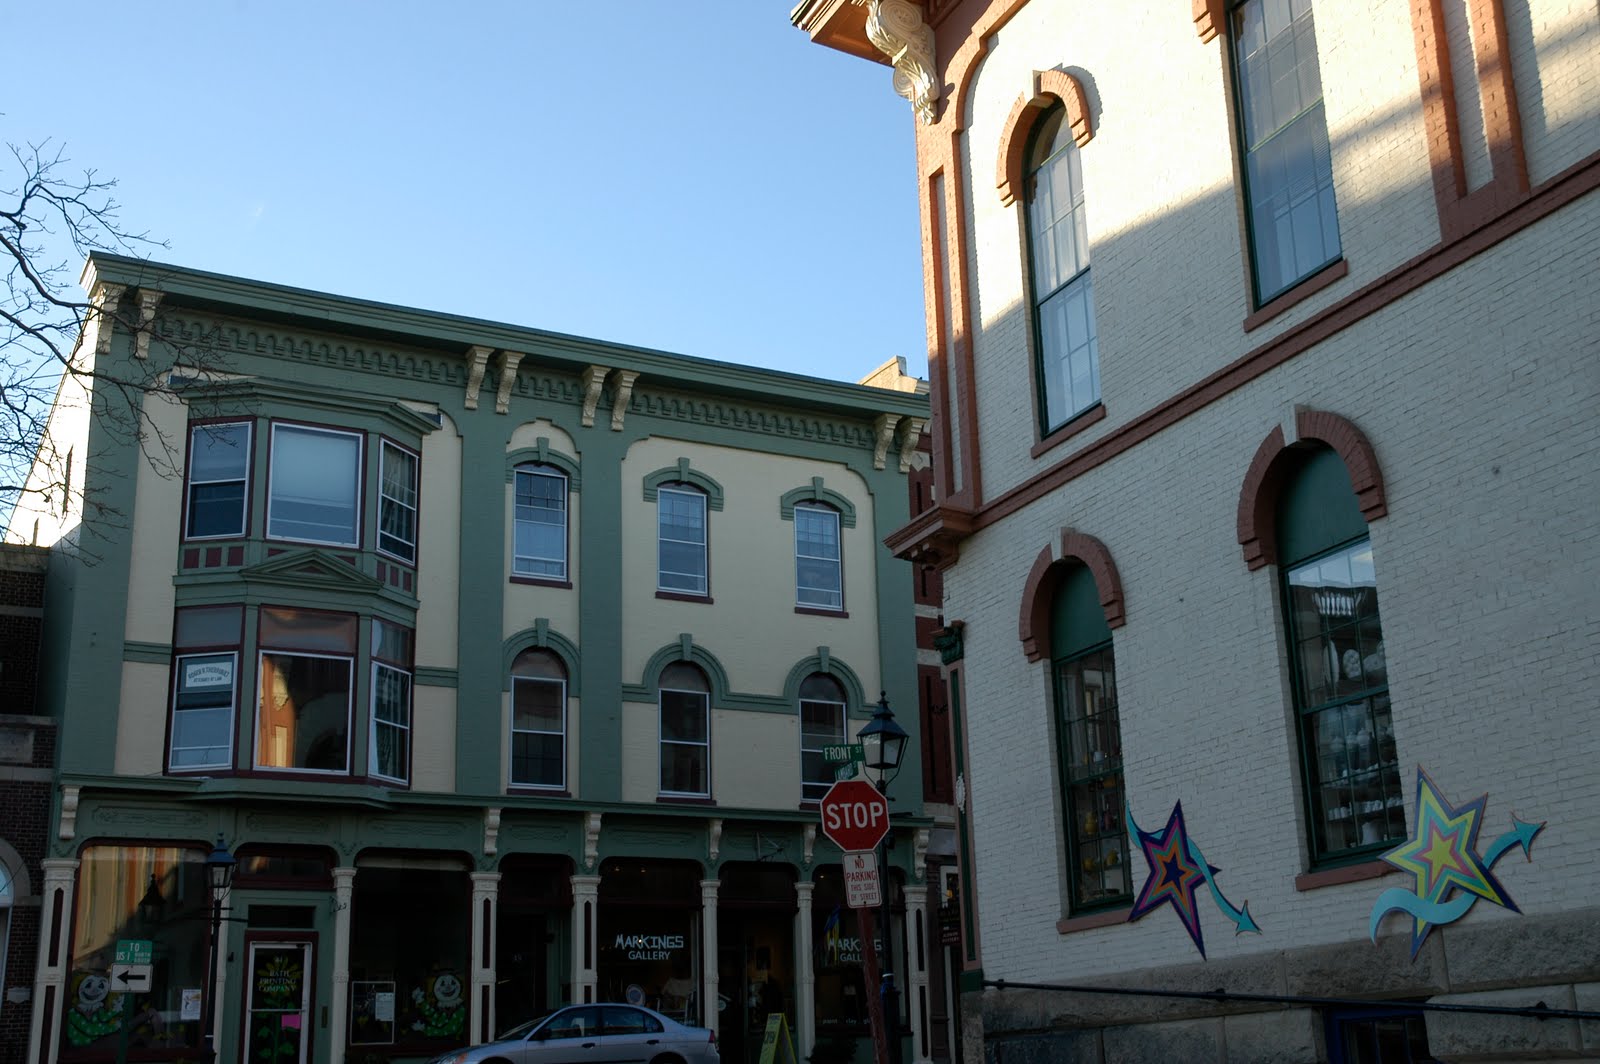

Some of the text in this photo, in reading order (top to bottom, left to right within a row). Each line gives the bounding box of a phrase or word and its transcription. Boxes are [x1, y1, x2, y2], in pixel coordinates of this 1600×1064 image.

[824, 746, 862, 760] FRONT ST
[826, 801, 884, 830] STOP
[854, 858, 865, 870] NO
[846, 870, 876, 882] PARKING
[851, 882, 875, 892] THIS SIDE
[860, 892, 877, 901] STREET
[130, 942, 140, 952] TO
[615, 933, 684, 951] MARKINGS
[627, 951, 671, 961] GALLERY
[269, 969, 291, 978] BATH
[259, 977, 297, 985] PRINTING
[258, 984, 297, 992] COMPANY
